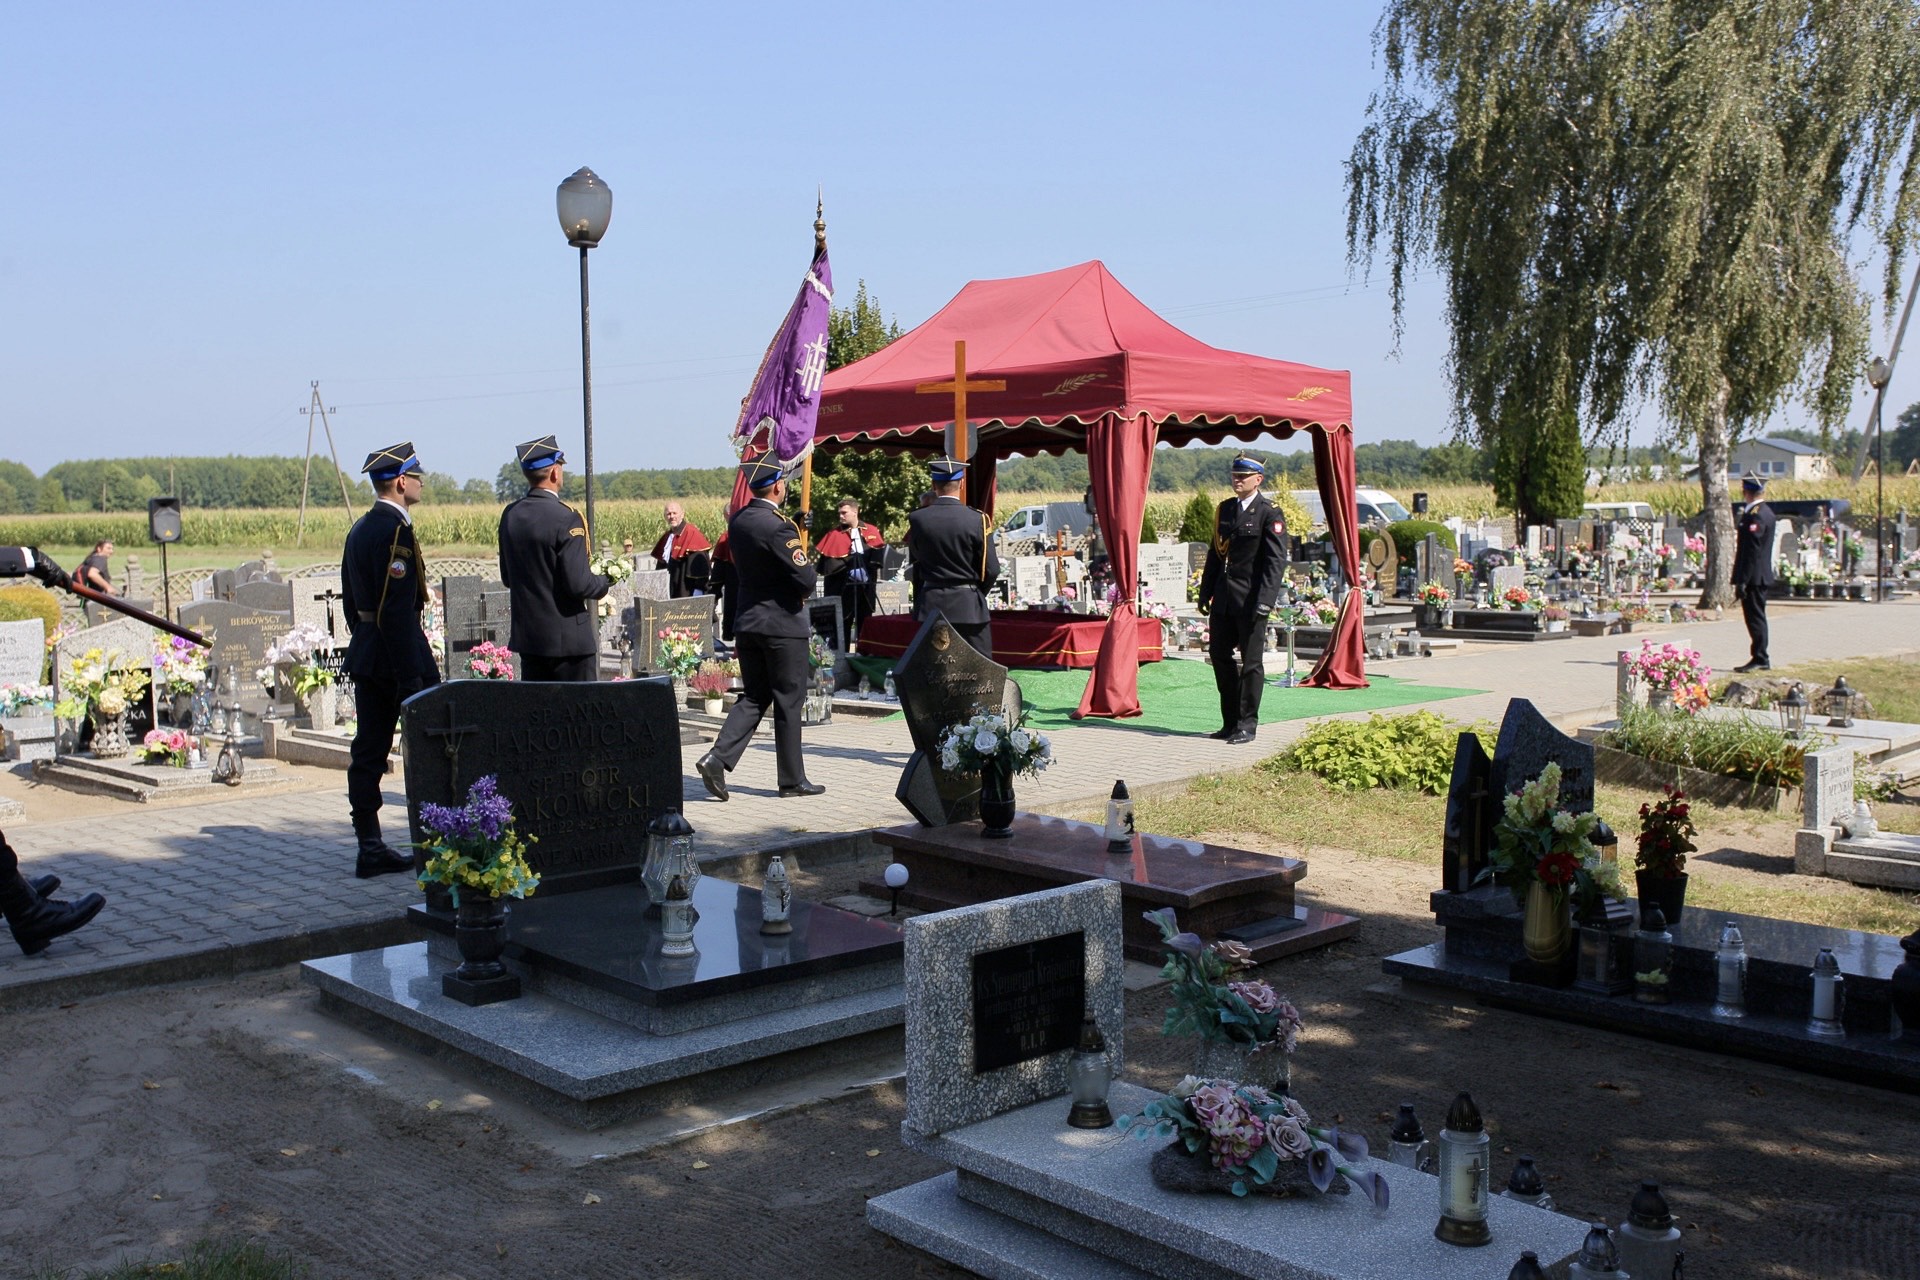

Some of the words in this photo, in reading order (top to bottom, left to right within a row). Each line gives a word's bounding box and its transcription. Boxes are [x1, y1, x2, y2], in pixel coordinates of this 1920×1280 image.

[563, 701, 620, 722] ANNA
[491, 720, 656, 755] JAKOWICKA
[562, 766, 620, 788] PIOTR
[510, 783, 650, 821] AKOWICKI
